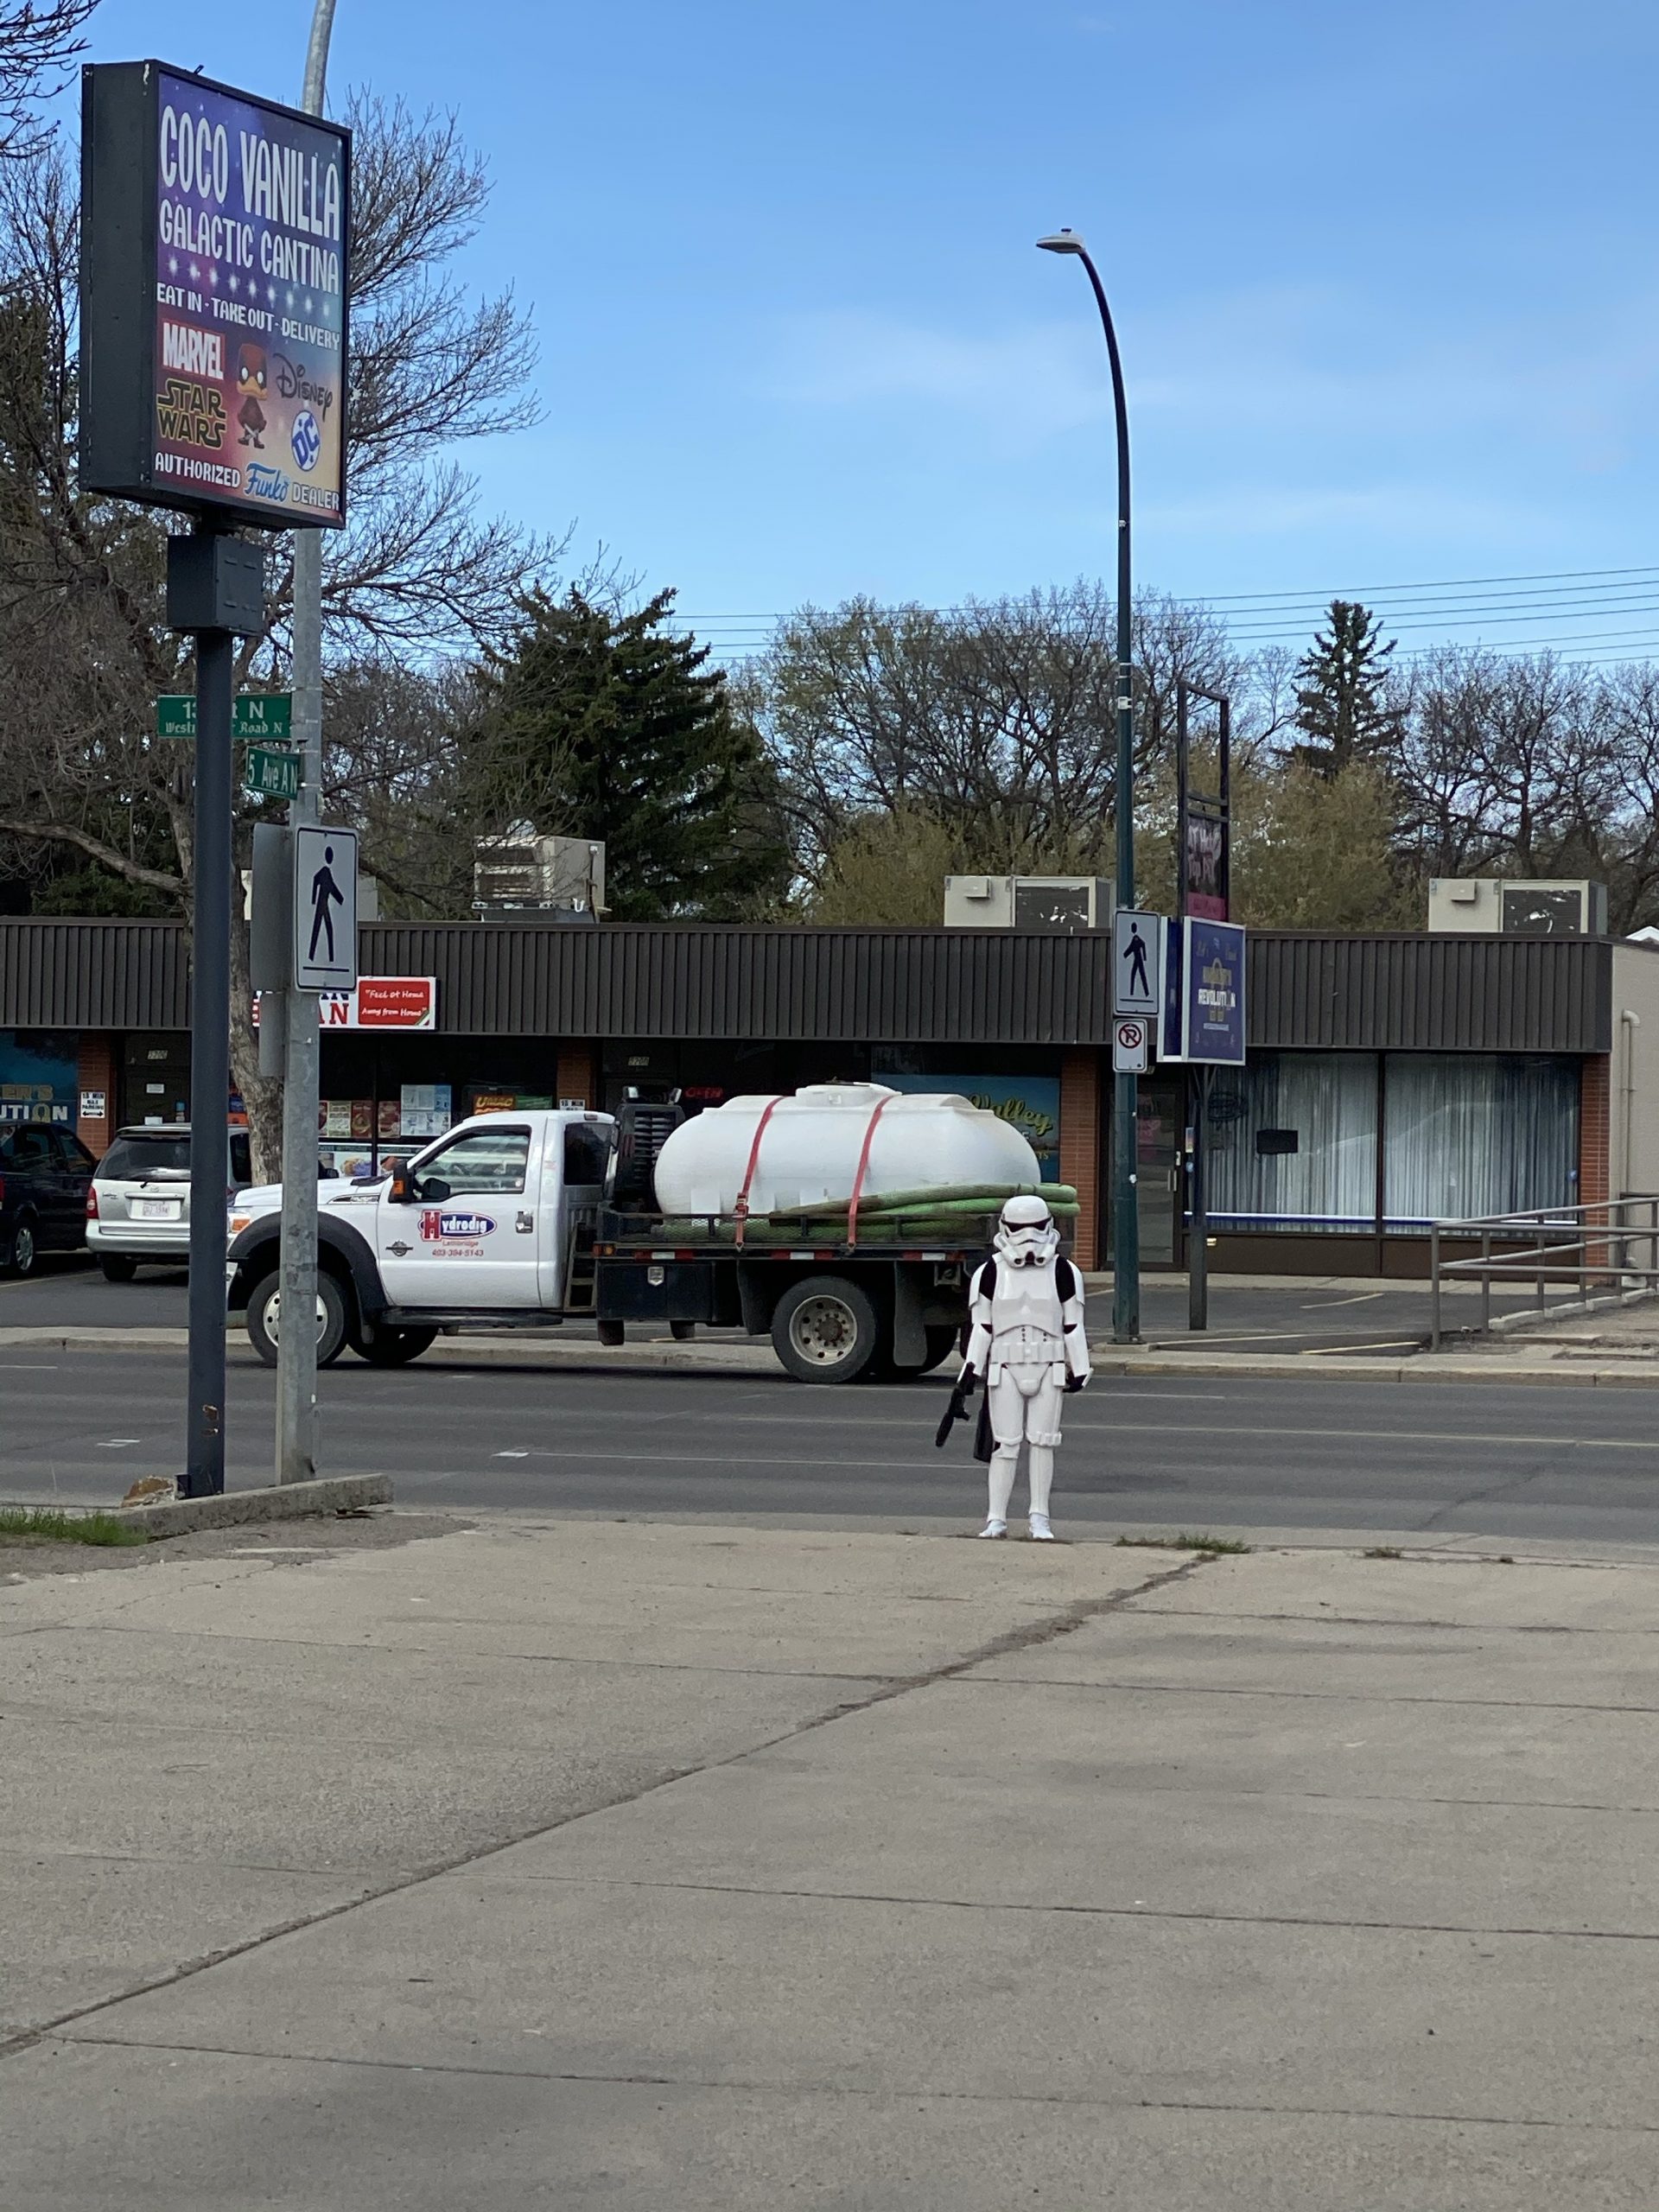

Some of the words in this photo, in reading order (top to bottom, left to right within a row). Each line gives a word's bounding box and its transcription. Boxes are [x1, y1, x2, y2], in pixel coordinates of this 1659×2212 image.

[161, 105, 228, 204] COCO
[240, 130, 340, 241] VANILLA
[160, 199, 253, 269] GALACTIC
[261, 230, 339, 295] CANTINA
[157, 282, 185, 308] EAT
[188, 290, 201, 313] IN
[211, 297, 246, 325] TAKE
[248, 308, 275, 332] OUT
[282, 317, 340, 351] DELIVERY
[163, 322, 224, 380] MARVEL
[156, 378, 227, 420] STAR
[156, 406, 227, 449] WARS
[292, 418, 321, 468] DC
[155, 453, 241, 488] AUTHORIZED
[244, 462, 289, 502] Funko
[292, 482, 340, 512] DEALER
[239, 721, 269, 734] Road
[273, 721, 283, 733] N
[249, 701, 264, 719] N
[247, 753, 255, 784] 5
[262, 757, 279, 790] Ave
[281, 762, 289, 791] A
[290, 764, 298, 794] N
[402, 990, 424, 999] Home
[423, 1212, 487, 1239] Hydrodig
